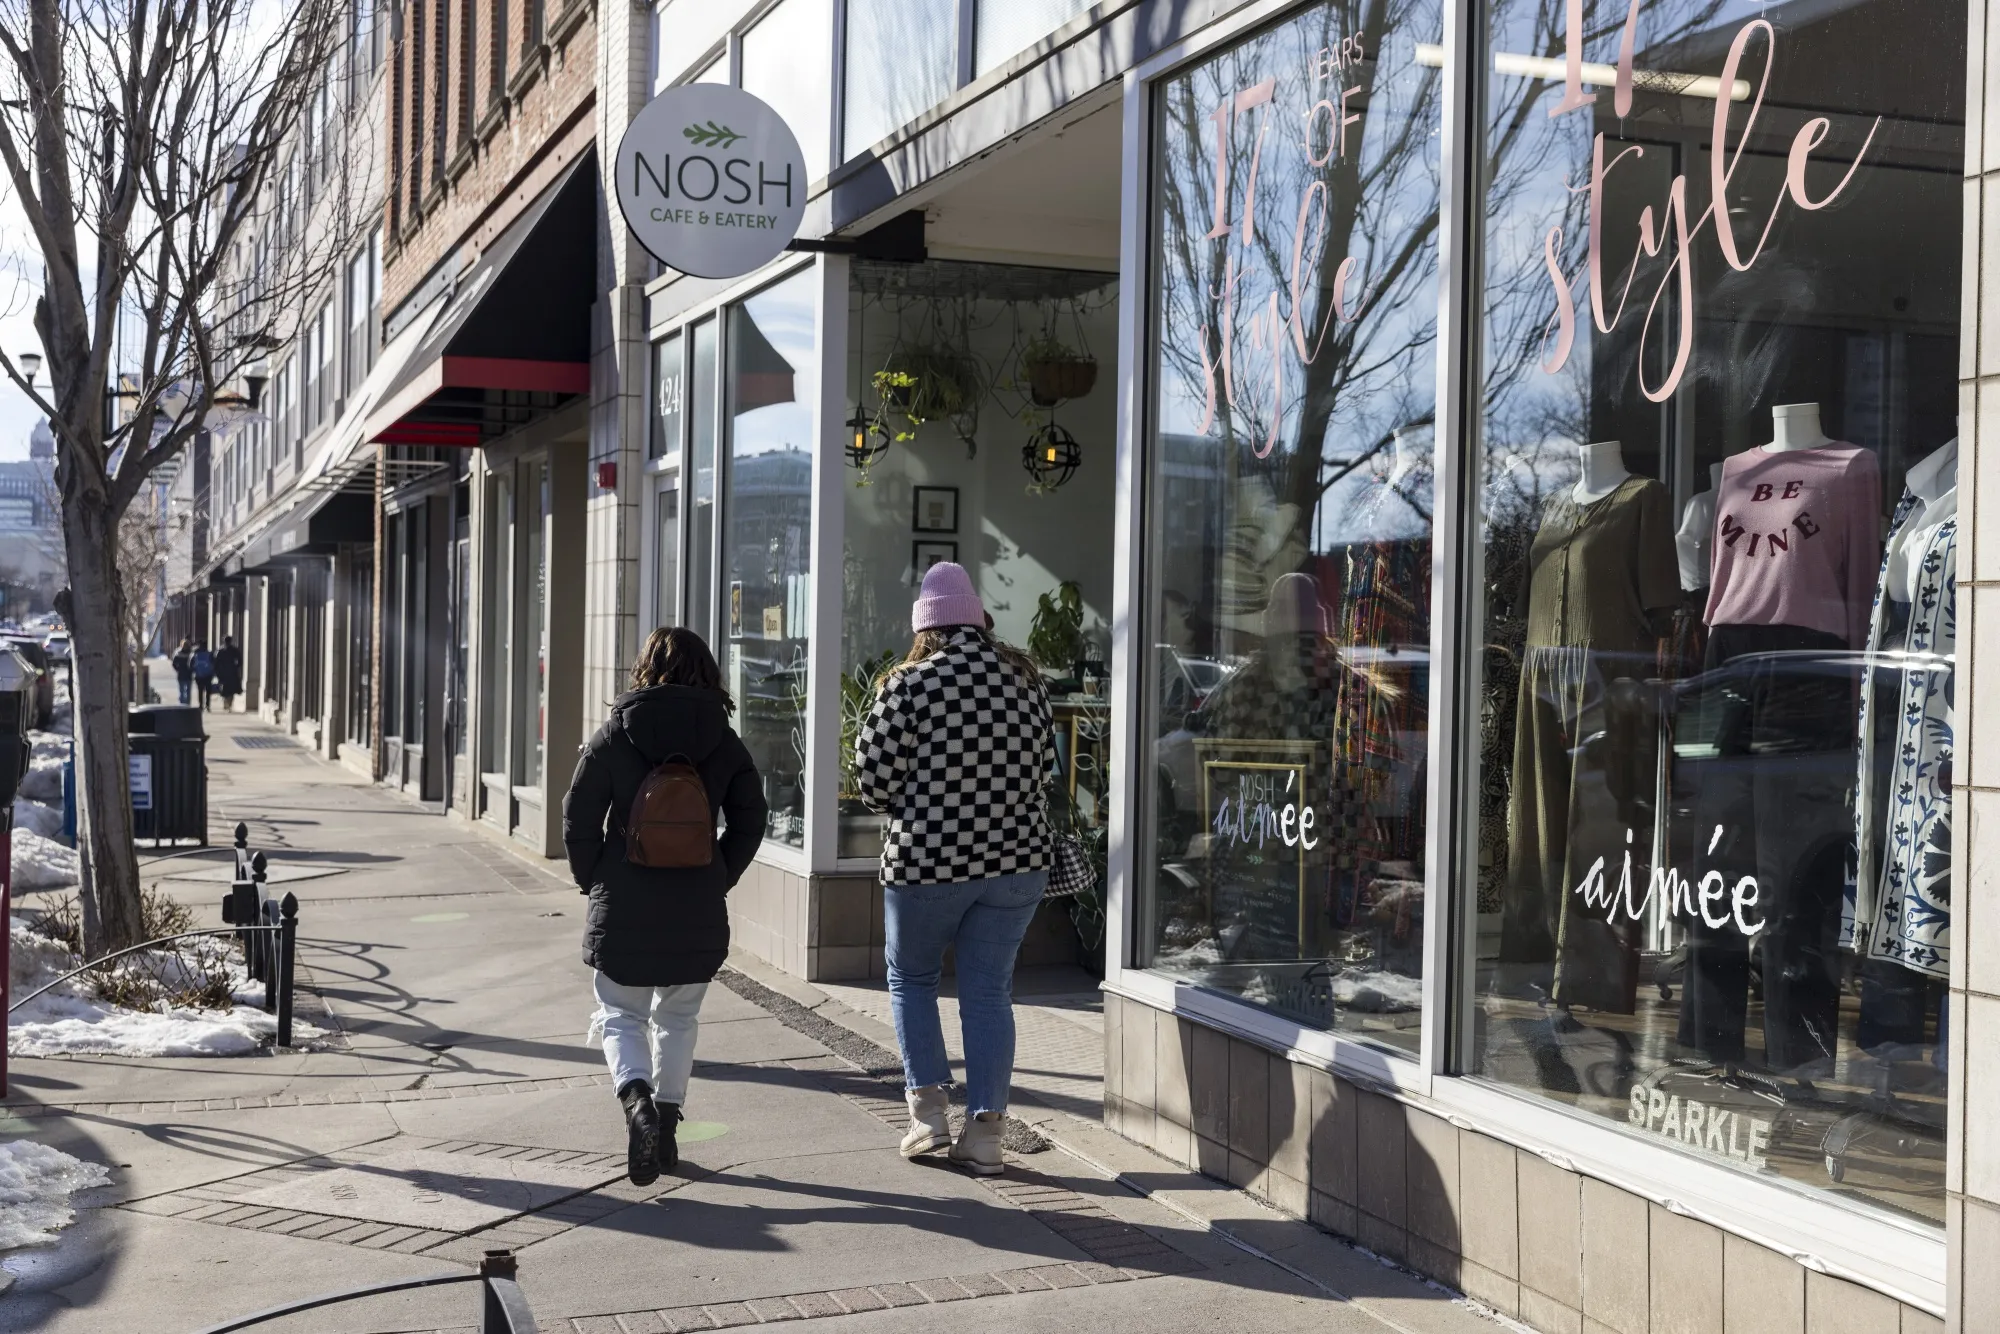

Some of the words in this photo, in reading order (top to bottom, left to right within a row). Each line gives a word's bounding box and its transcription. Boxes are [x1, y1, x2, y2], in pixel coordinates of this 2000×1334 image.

[1308, 31, 1364, 83] YEARS
[1207, 77, 1275, 247] 17
[1306, 85, 1361, 168] OF
[634, 151, 792, 208] NOSH
[650, 207, 694, 224] CAFE
[698, 210, 710, 225] &
[715, 211, 778, 229] EATERY
[1540, 19, 1881, 402] style
[1196, 181, 1381, 458] style
[1751, 479, 1804, 502] BE
[1720, 511, 1821, 557] MINE
[1212, 769, 1318, 850] aimée
[1240, 774, 1274, 803] NOSH
[1575, 824, 1766, 936] aimée
[1628, 1085, 1772, 1163] SPARKLE
